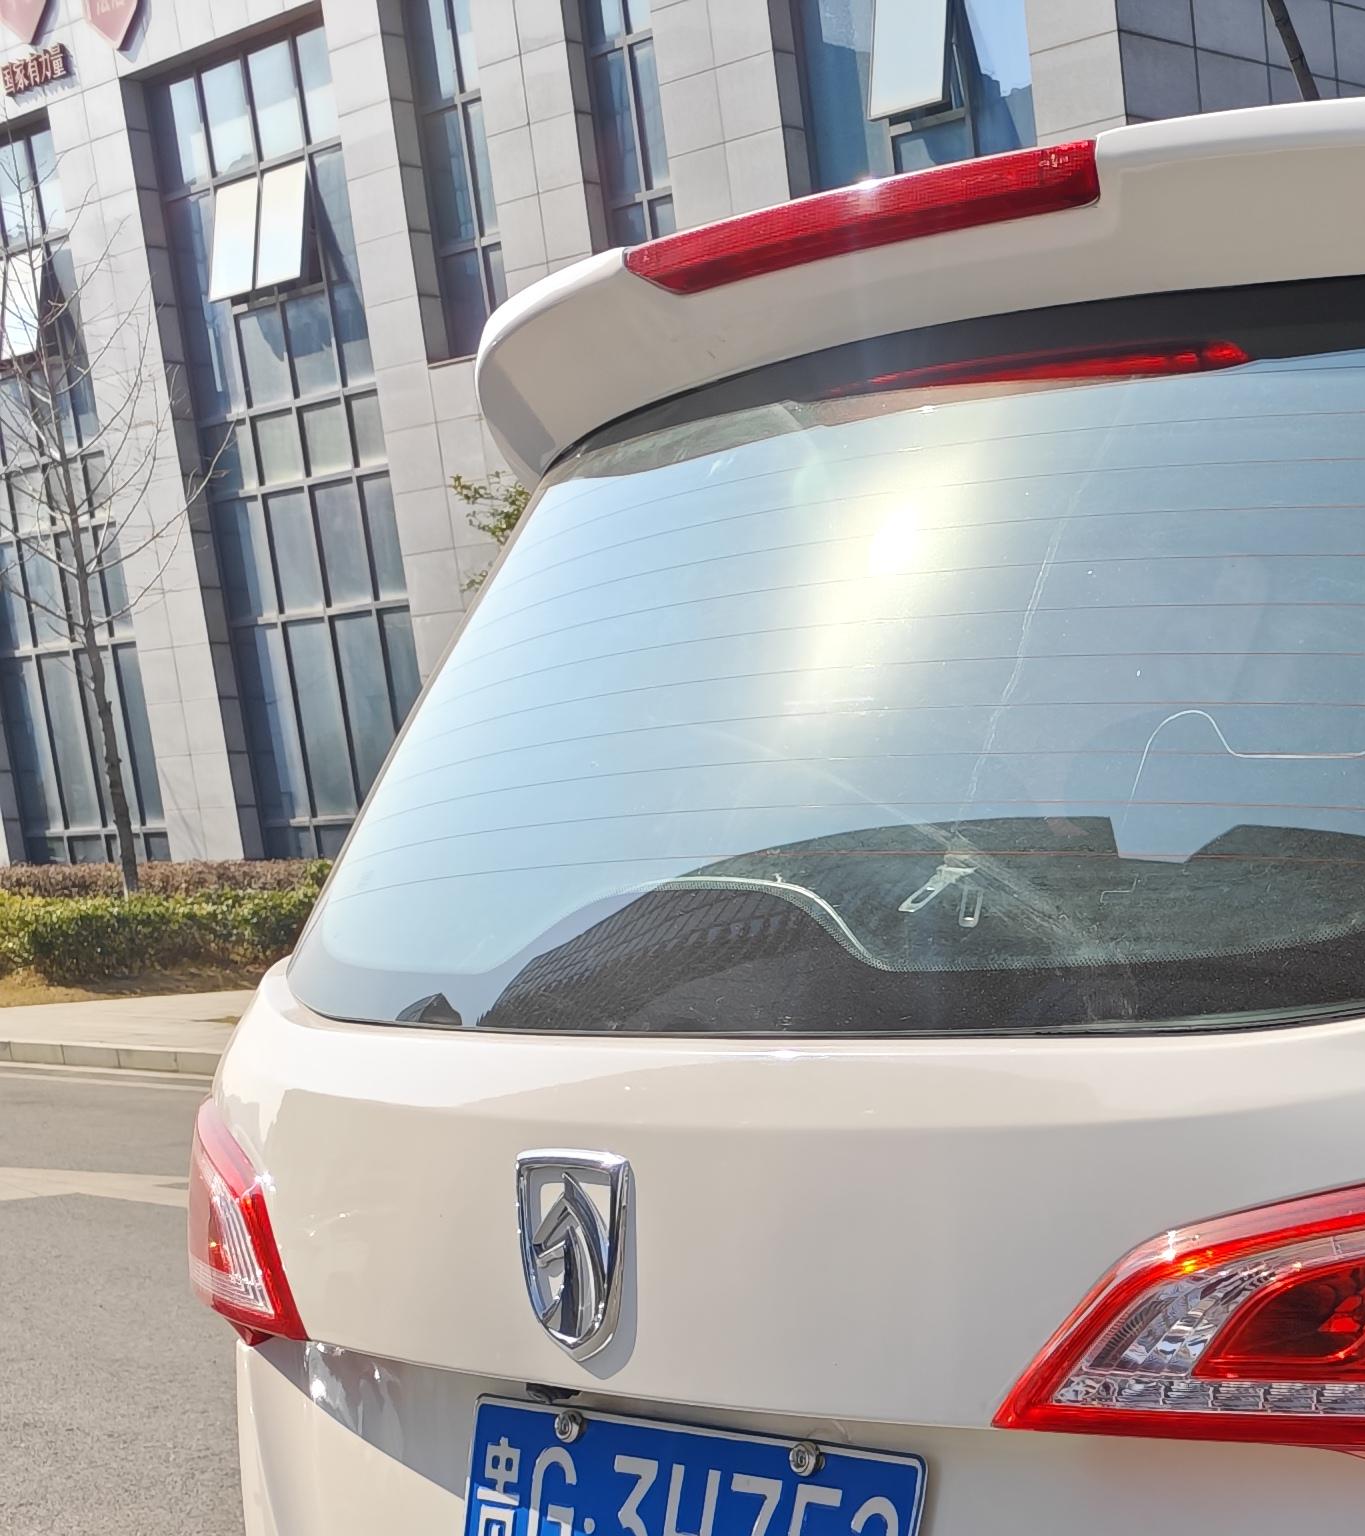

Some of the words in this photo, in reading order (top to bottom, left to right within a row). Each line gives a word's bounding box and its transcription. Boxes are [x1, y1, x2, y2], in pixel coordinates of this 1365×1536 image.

[1, 45, 67, 94] 国家有力量
